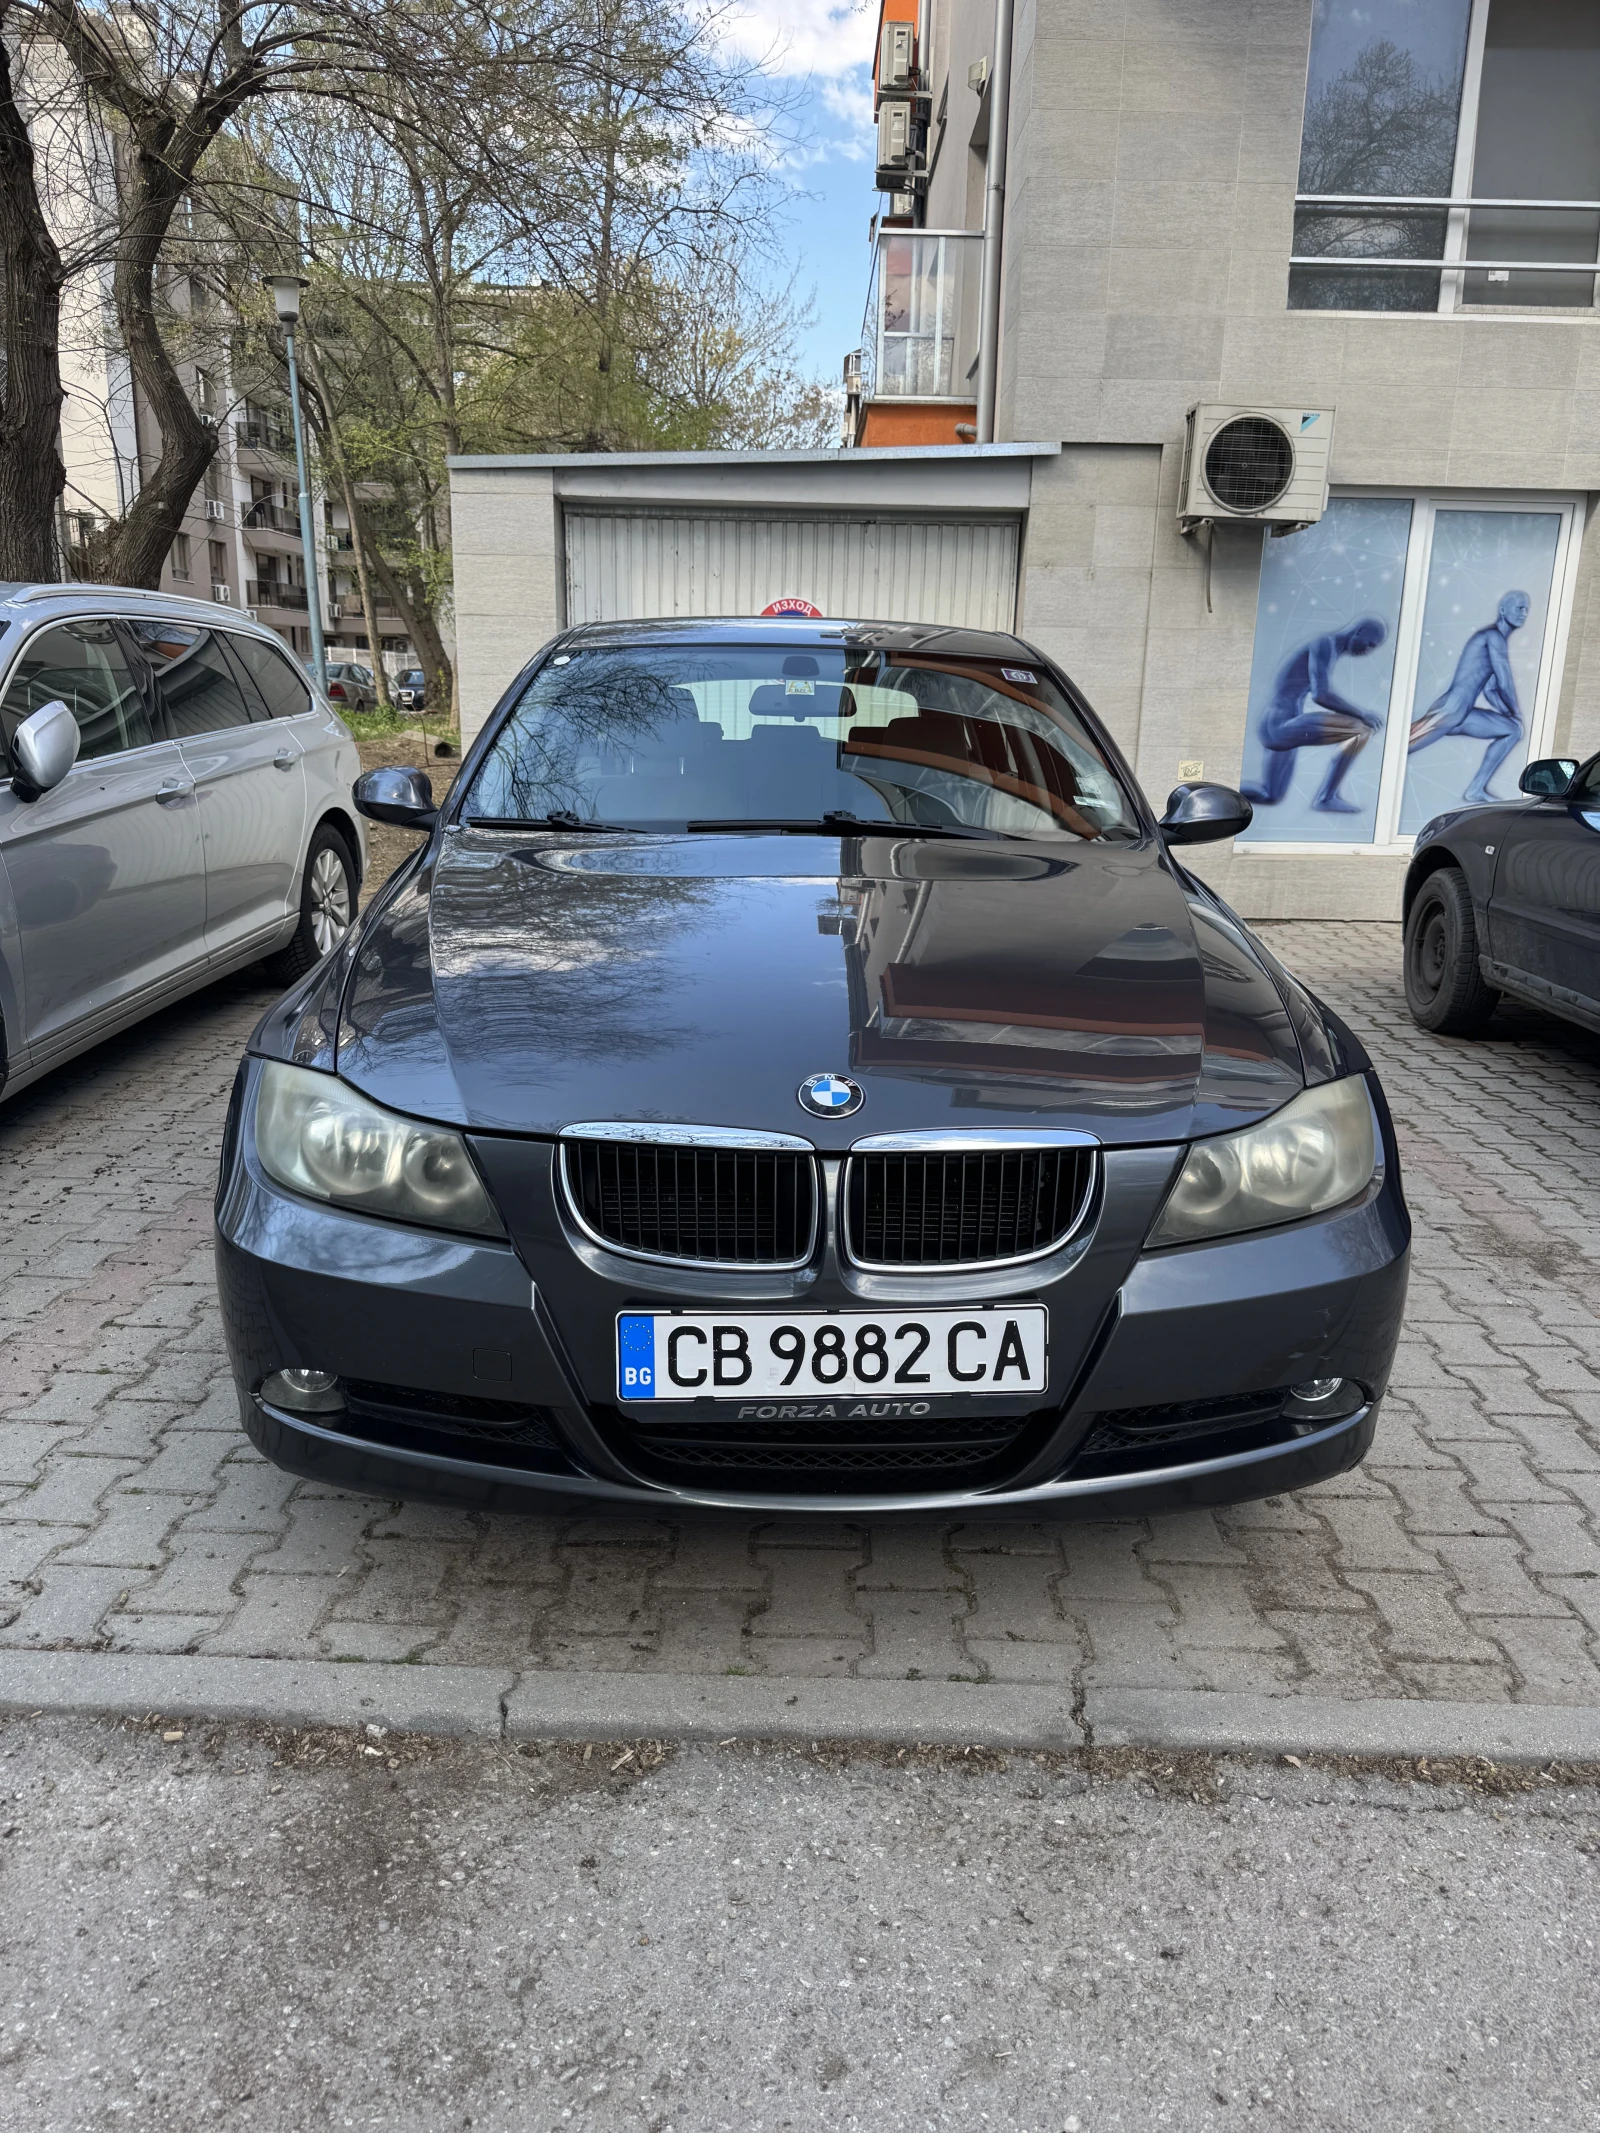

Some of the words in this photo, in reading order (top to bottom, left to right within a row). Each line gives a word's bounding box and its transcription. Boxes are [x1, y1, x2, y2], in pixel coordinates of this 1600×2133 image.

[772, 599, 813, 617] ИЗХОД
[804, 1074, 857, 1087] BMW
[667, 1325, 753, 1387] CB
[769, 1322, 931, 1386] 9882
[947, 1320, 1031, 1382] CA
[625, 1367, 652, 1386] BG
[737, 1405, 837, 1419] FORZA
[847, 1402, 931, 1417] AUTO
